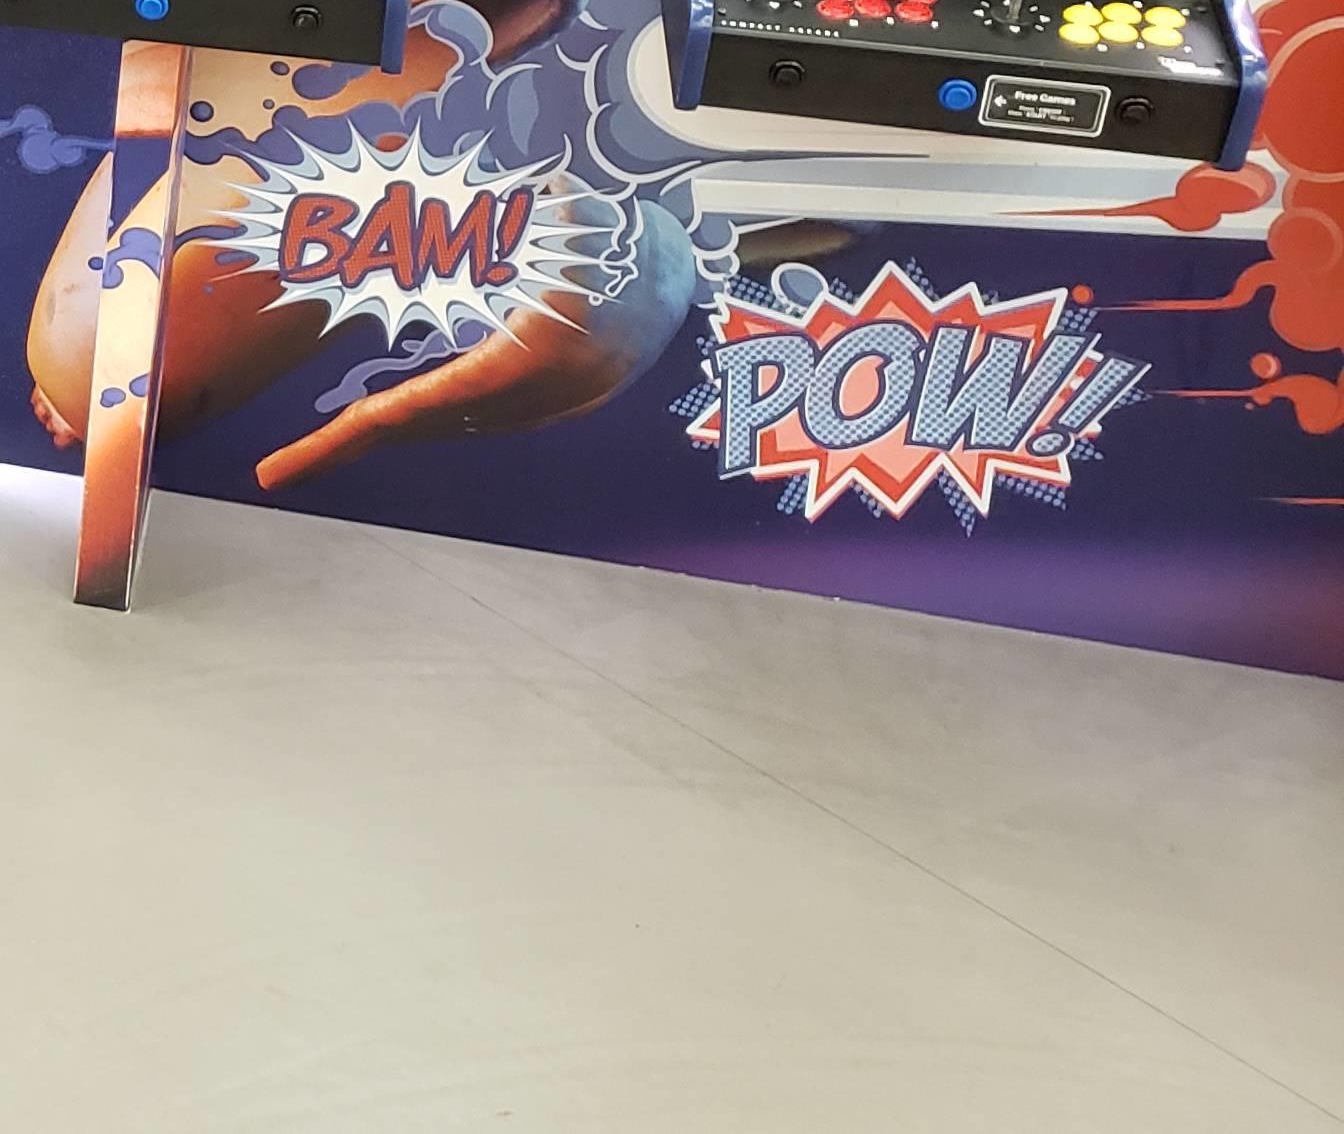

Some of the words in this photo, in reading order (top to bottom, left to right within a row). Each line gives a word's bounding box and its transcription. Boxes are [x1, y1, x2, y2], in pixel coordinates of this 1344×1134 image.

[1014, 90, 1039, 103] Free
[1039, 92, 1077, 107] Games
[278, 180, 535, 291] BAM!
[712, 318, 1152, 472] POW!
